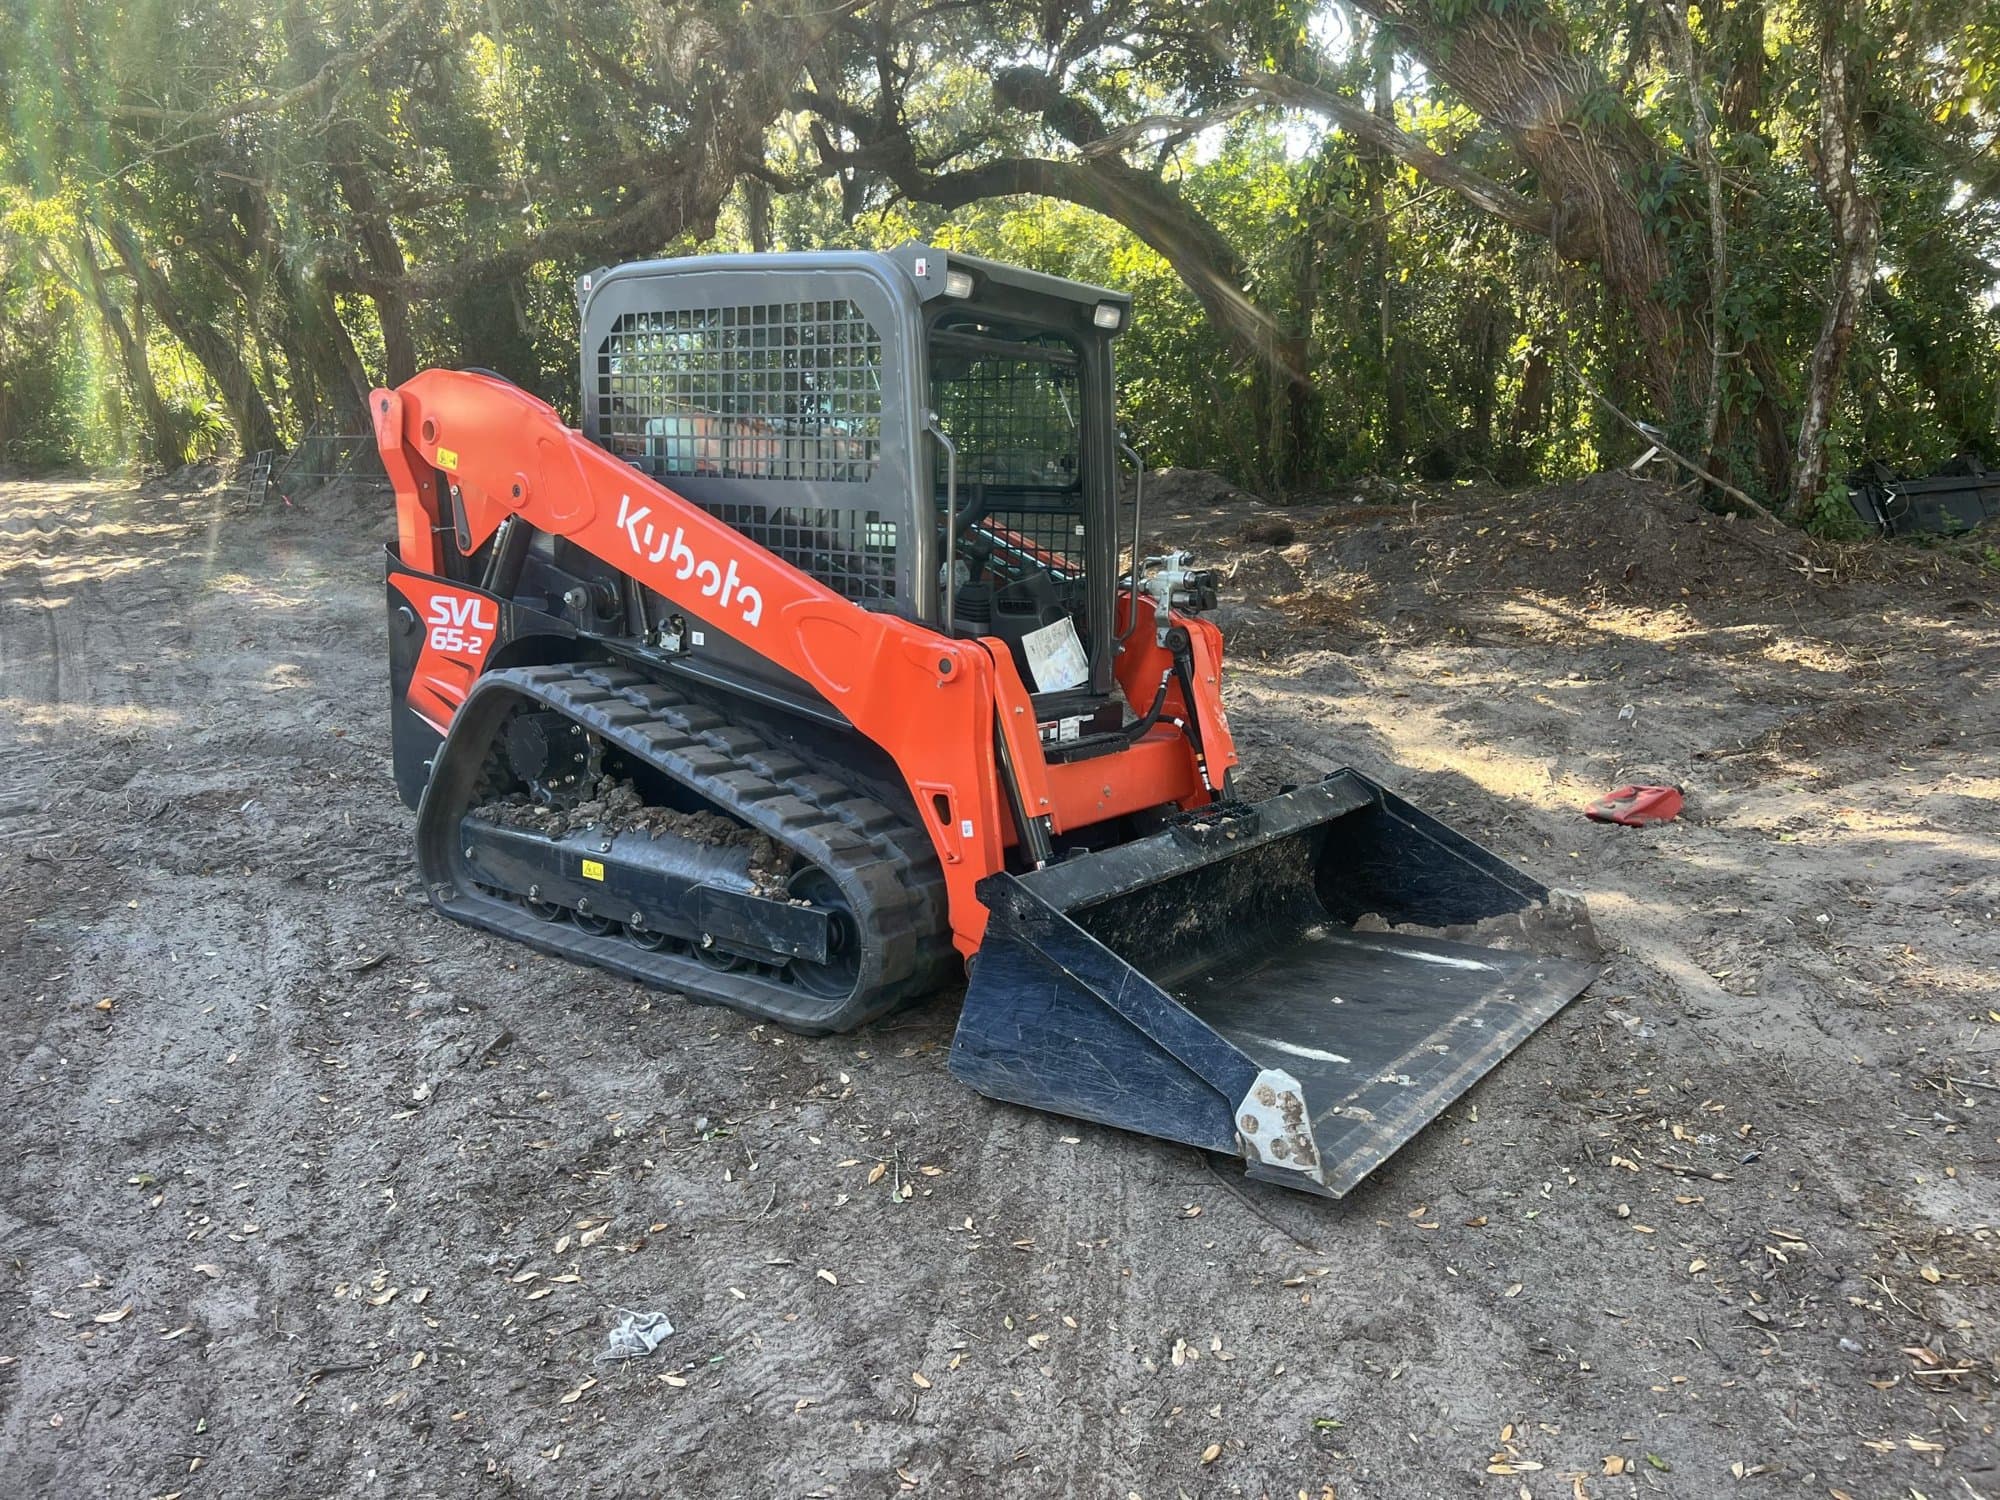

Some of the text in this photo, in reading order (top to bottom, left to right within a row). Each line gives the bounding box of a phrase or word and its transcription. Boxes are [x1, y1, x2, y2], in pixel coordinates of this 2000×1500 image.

[616, 494, 763, 627] Kubota
[428, 595, 494, 630] SVL
[430, 626, 482, 655] 65-2
